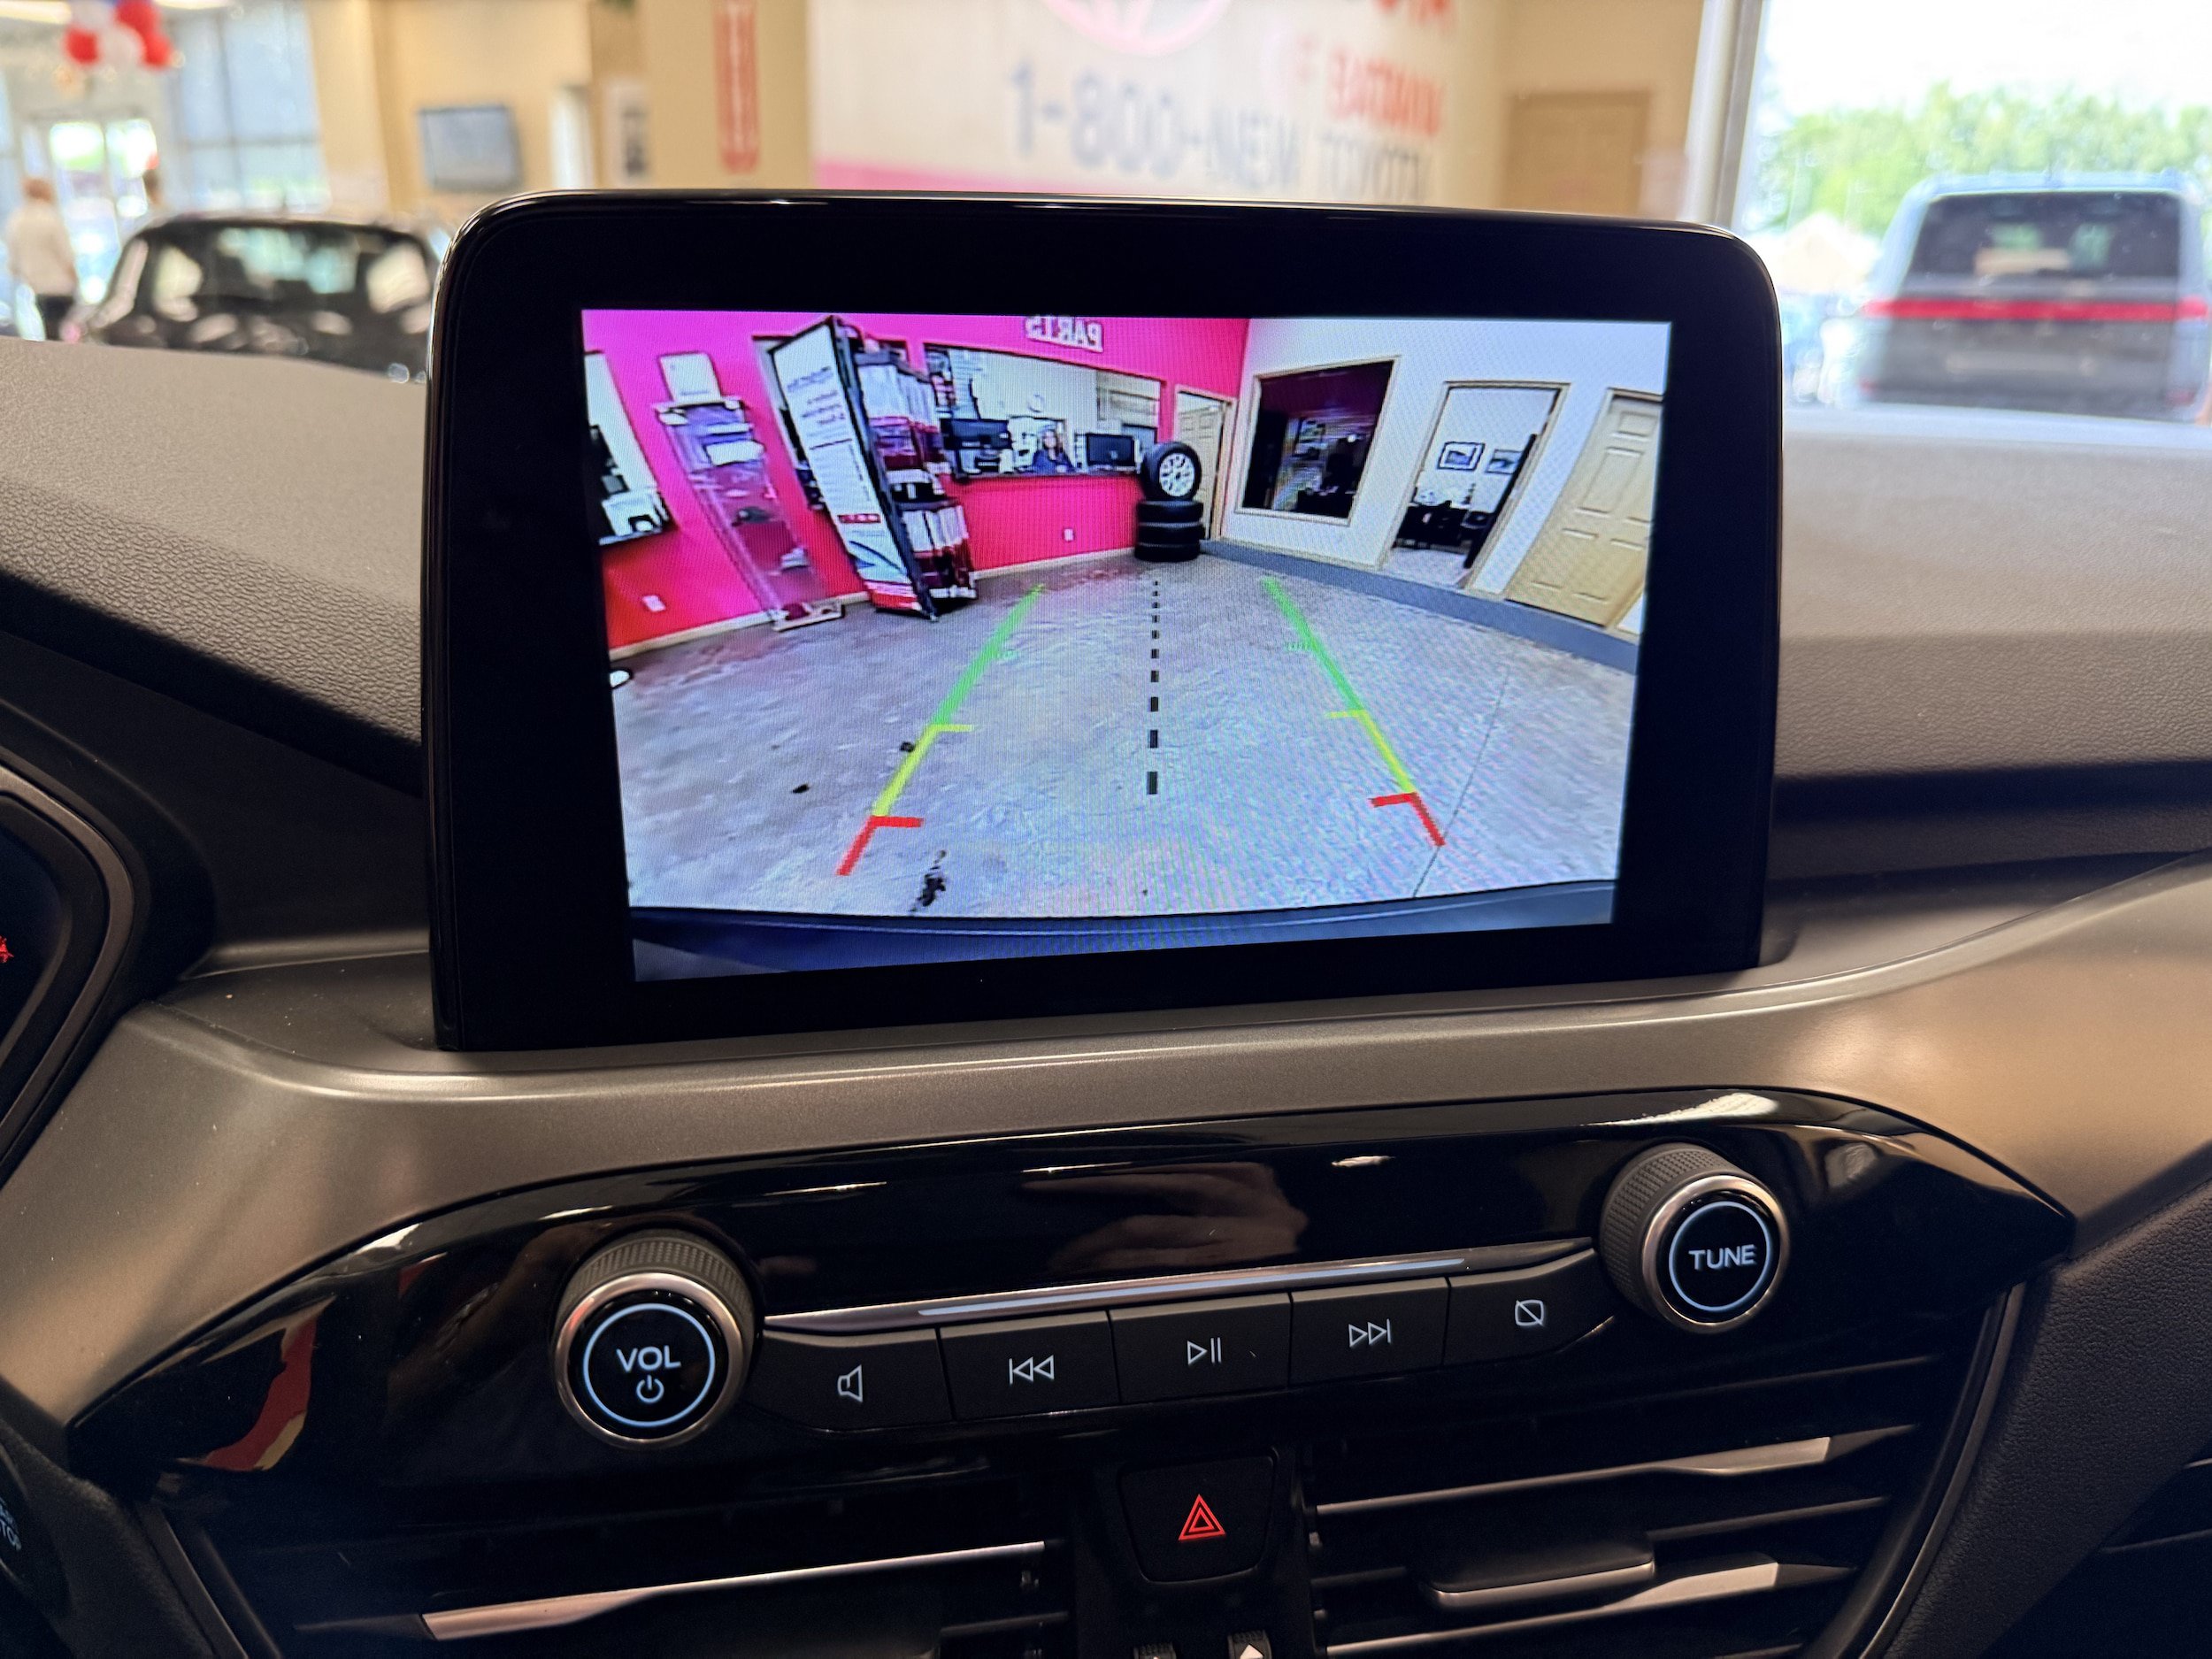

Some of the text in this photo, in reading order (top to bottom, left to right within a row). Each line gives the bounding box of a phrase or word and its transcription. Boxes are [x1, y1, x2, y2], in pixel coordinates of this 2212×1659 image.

[1688, 1244, 1756, 1270] TUNE
[617, 1345, 681, 1371] VOL
[0, 1517, 22, 1550] TOP
